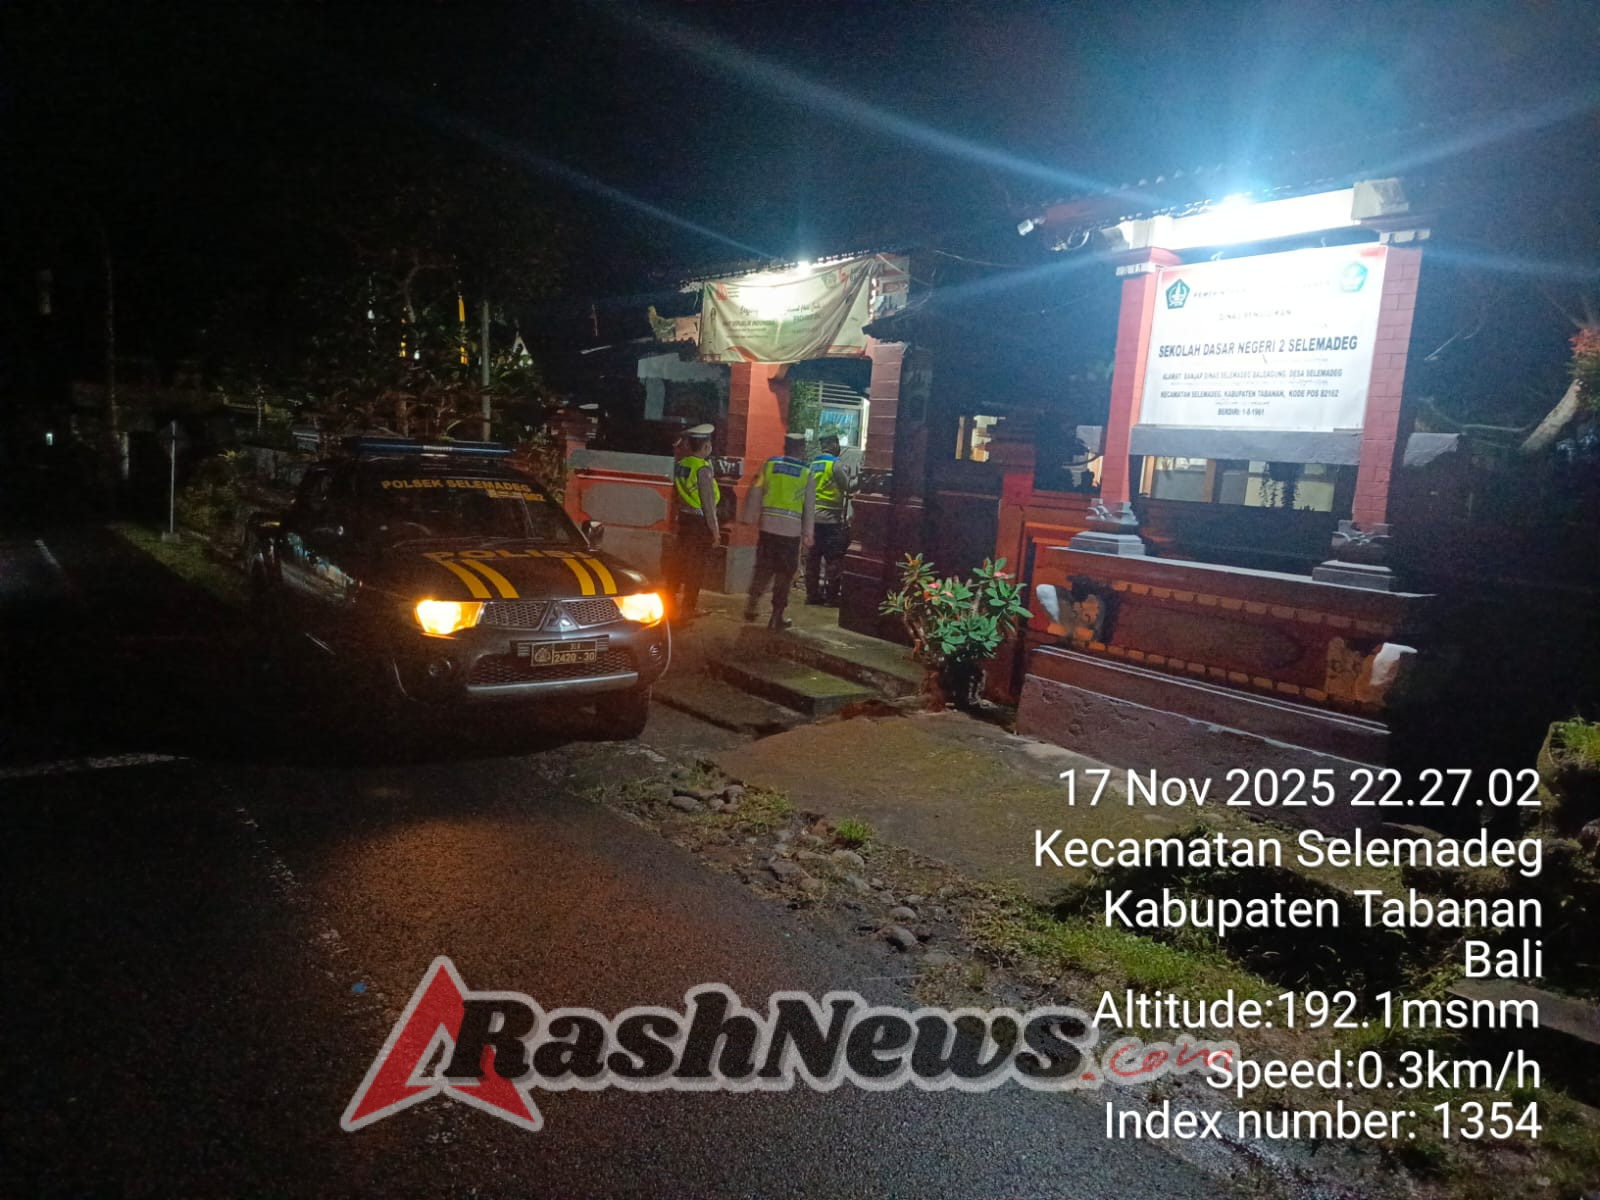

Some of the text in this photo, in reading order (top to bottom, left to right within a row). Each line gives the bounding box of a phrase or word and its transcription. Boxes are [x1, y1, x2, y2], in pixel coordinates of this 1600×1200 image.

[1158, 335, 1358, 358] SEKOLAH DASAR NEGERI 2 SELEMADEG
[1289, 369, 1304, 378] DESA
[1306, 368, 1343, 377] SELEMADEG
[1288, 389, 1305, 397] KODE
[1306, 389, 1319, 397] POS
[381, 479, 442, 490] POLSEK
